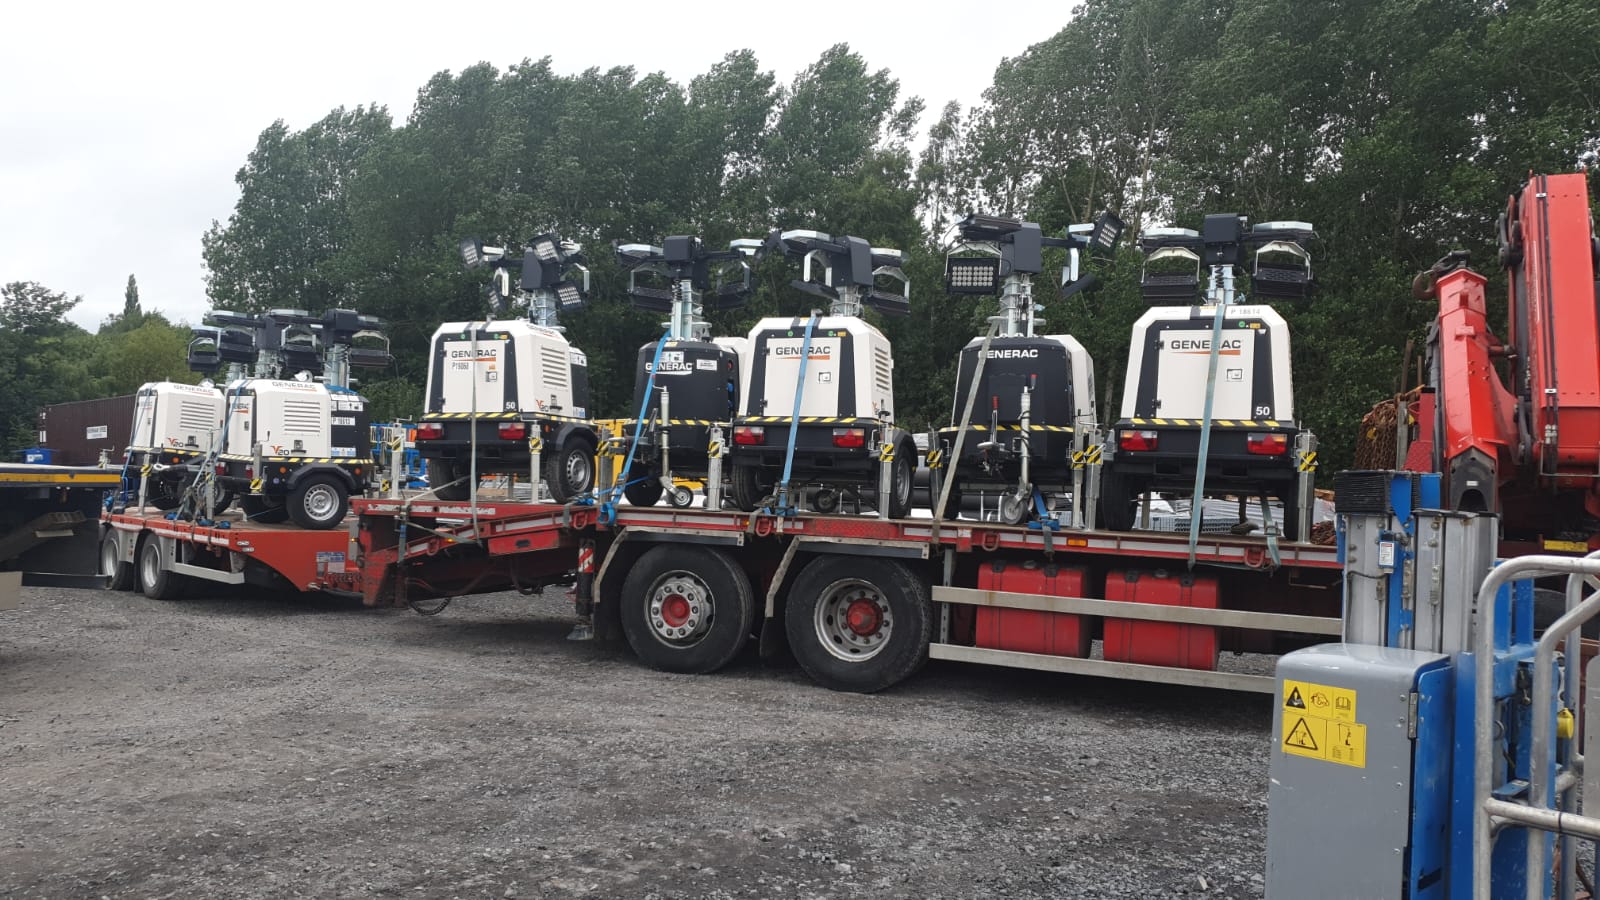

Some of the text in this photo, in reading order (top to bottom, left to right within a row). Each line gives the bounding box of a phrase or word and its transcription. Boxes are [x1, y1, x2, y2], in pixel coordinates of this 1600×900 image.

[1171, 340, 1241, 349] GENEAC
[645, 362, 693, 371] GNERAC
[173, 384, 214, 394] GENERAC
[271, 381, 315, 390] GENERAC
[1255, 406, 1270, 416] 50
[168, 437, 183, 447] V20
[270, 445, 290, 456] V20
